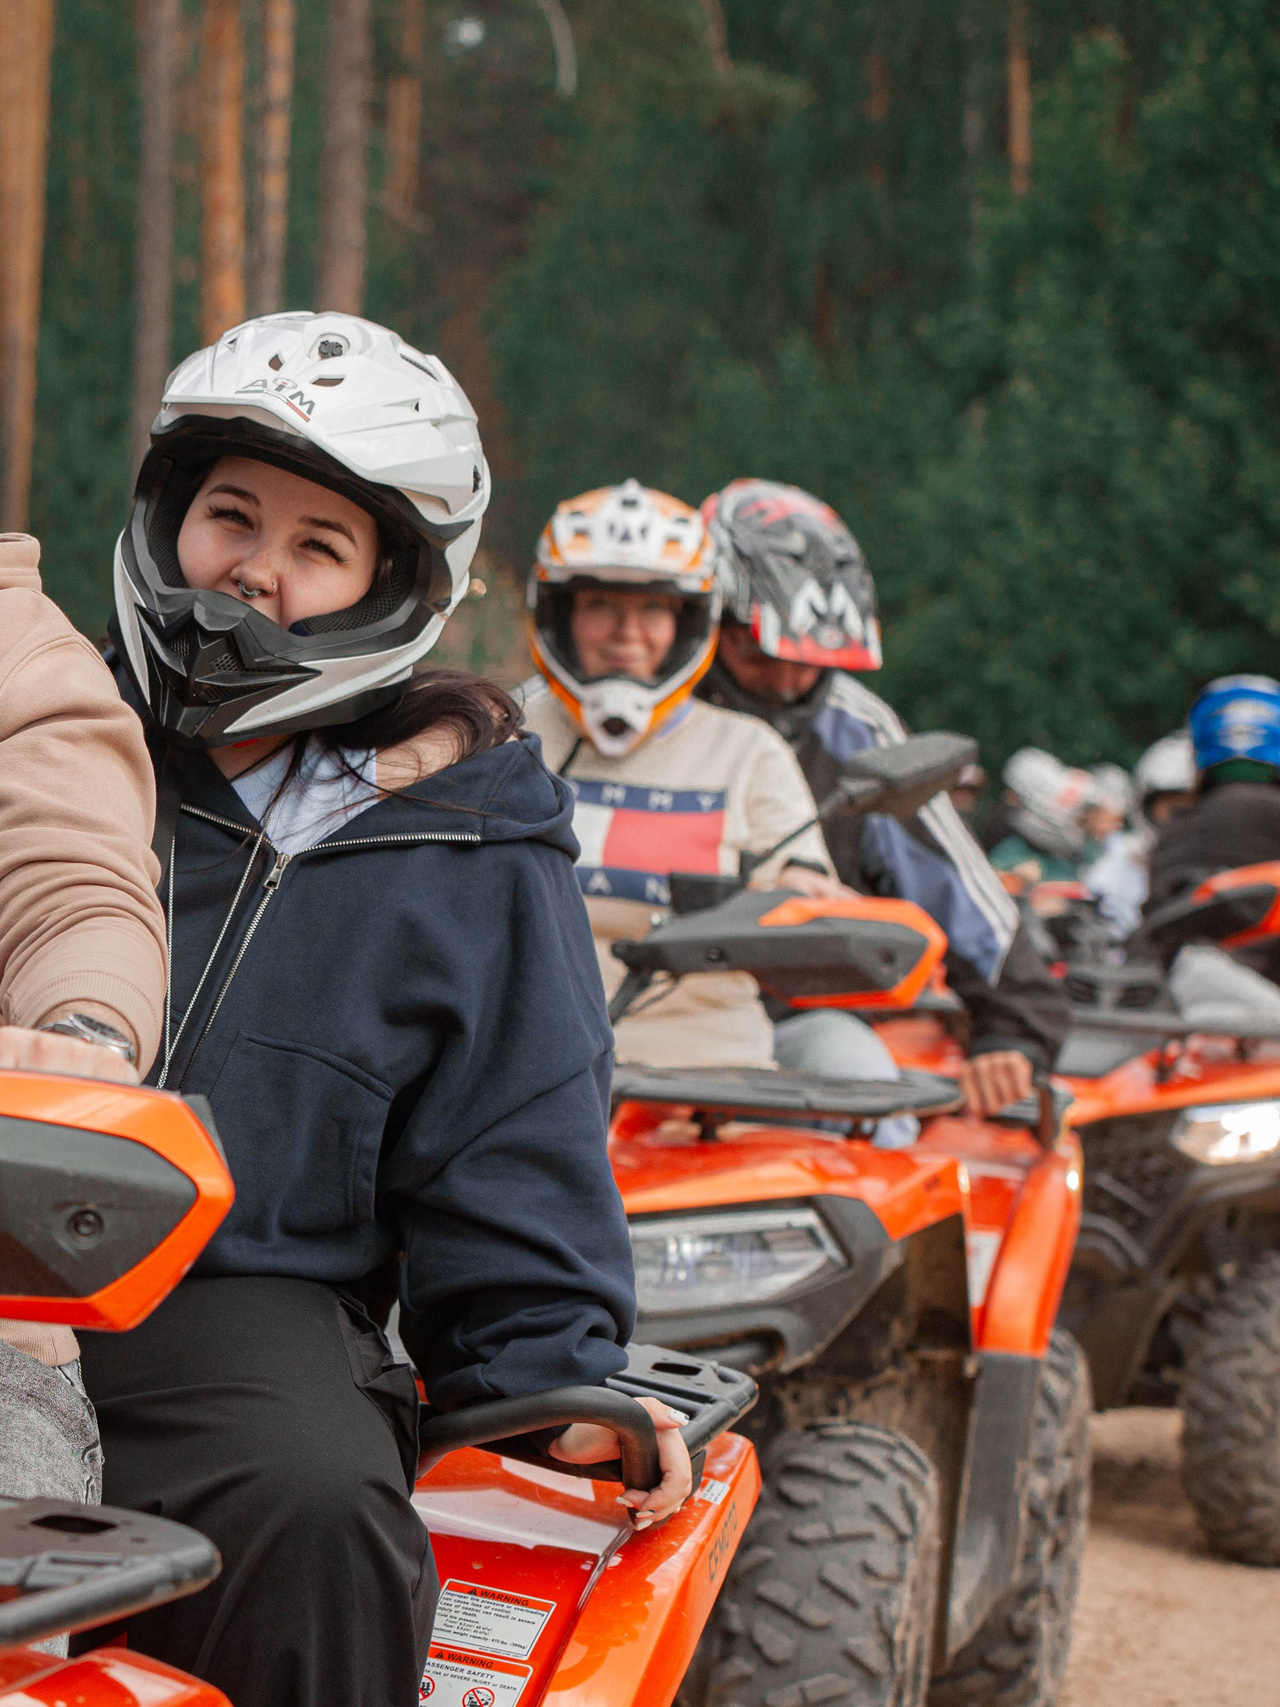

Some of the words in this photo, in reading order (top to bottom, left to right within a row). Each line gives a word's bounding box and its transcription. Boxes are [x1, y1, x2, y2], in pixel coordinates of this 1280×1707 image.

[480, 1590, 529, 1606] WARNING
[514, 1607, 546, 1617] overloading
[447, 1653, 494, 1669] WARNING
[426, 1661, 465, 1673] ASSENGER
[467, 1669, 496, 1680] SAFETY
[450, 1674, 471, 1682] SEVERE
[499, 1683, 517, 1691] DEATH
